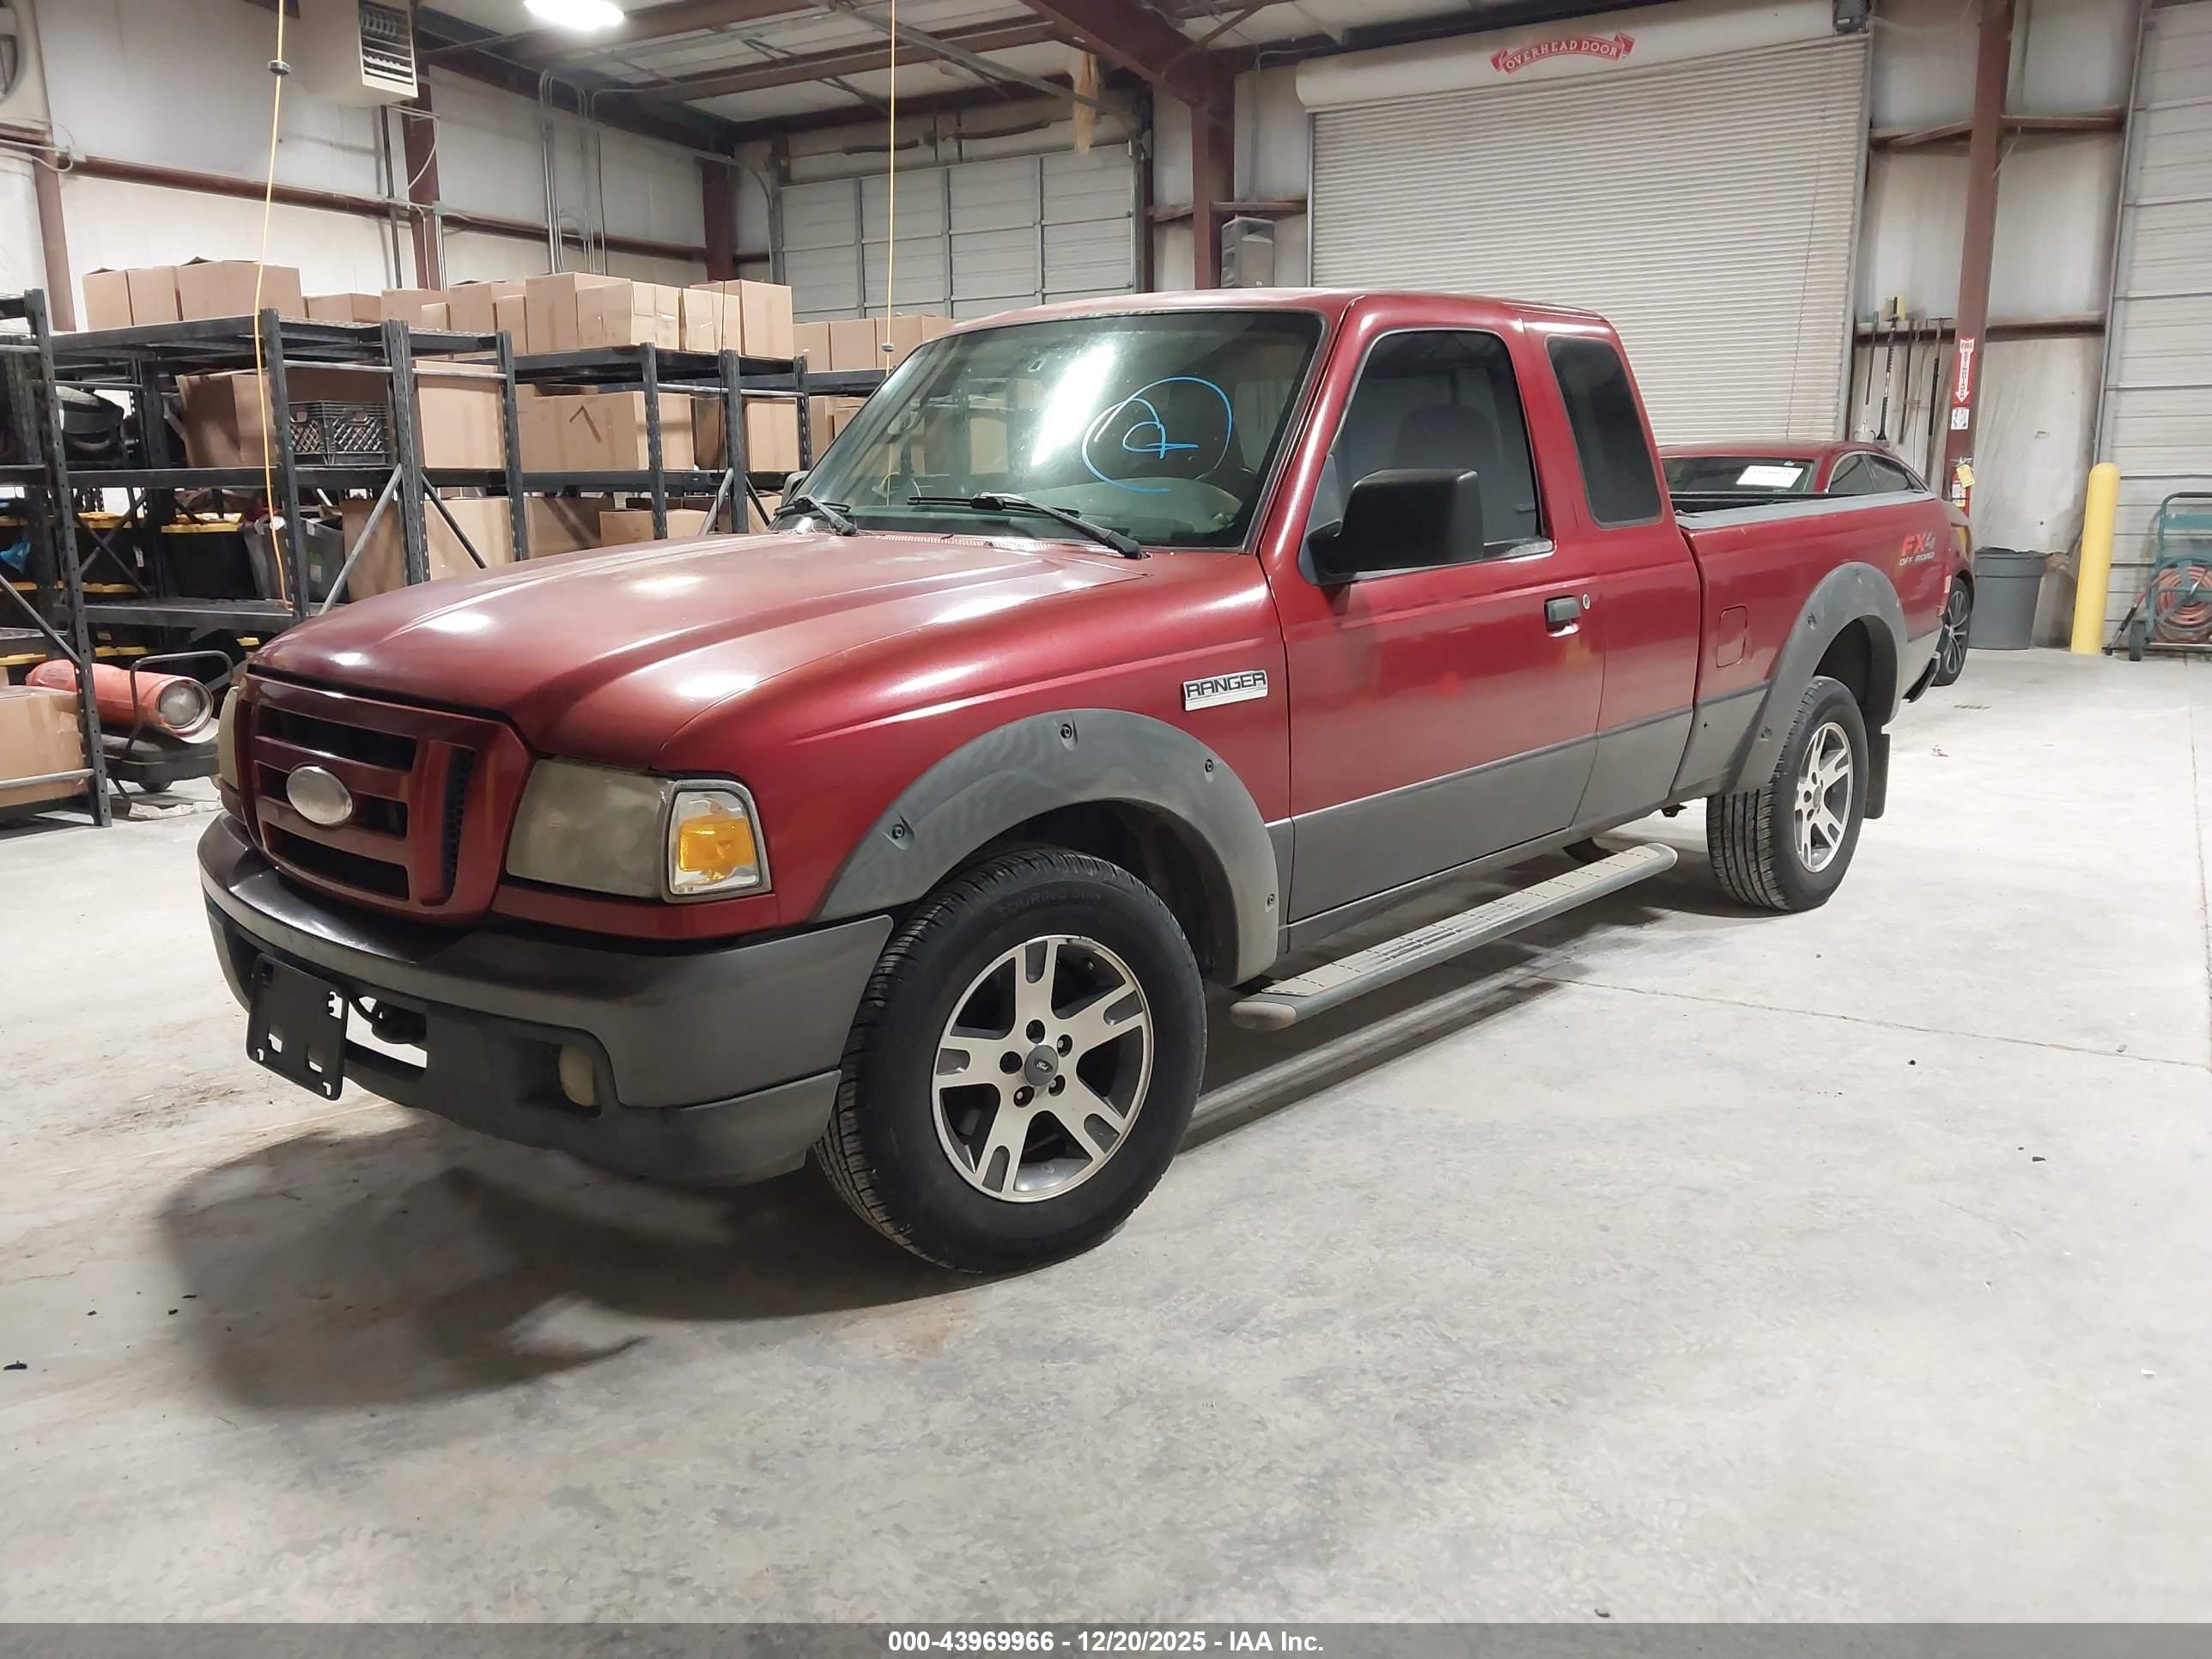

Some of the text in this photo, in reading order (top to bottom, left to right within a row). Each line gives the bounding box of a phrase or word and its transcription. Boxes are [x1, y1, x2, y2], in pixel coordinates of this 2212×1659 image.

[1505, 40, 1619, 70] OVERHEAD DOOR
[1900, 532, 1936, 556] FX4
[1899, 551, 1936, 567] OFF ROAD
[1185, 672, 1267, 697] RANGER
[995, 888, 1068, 918] TOURING
